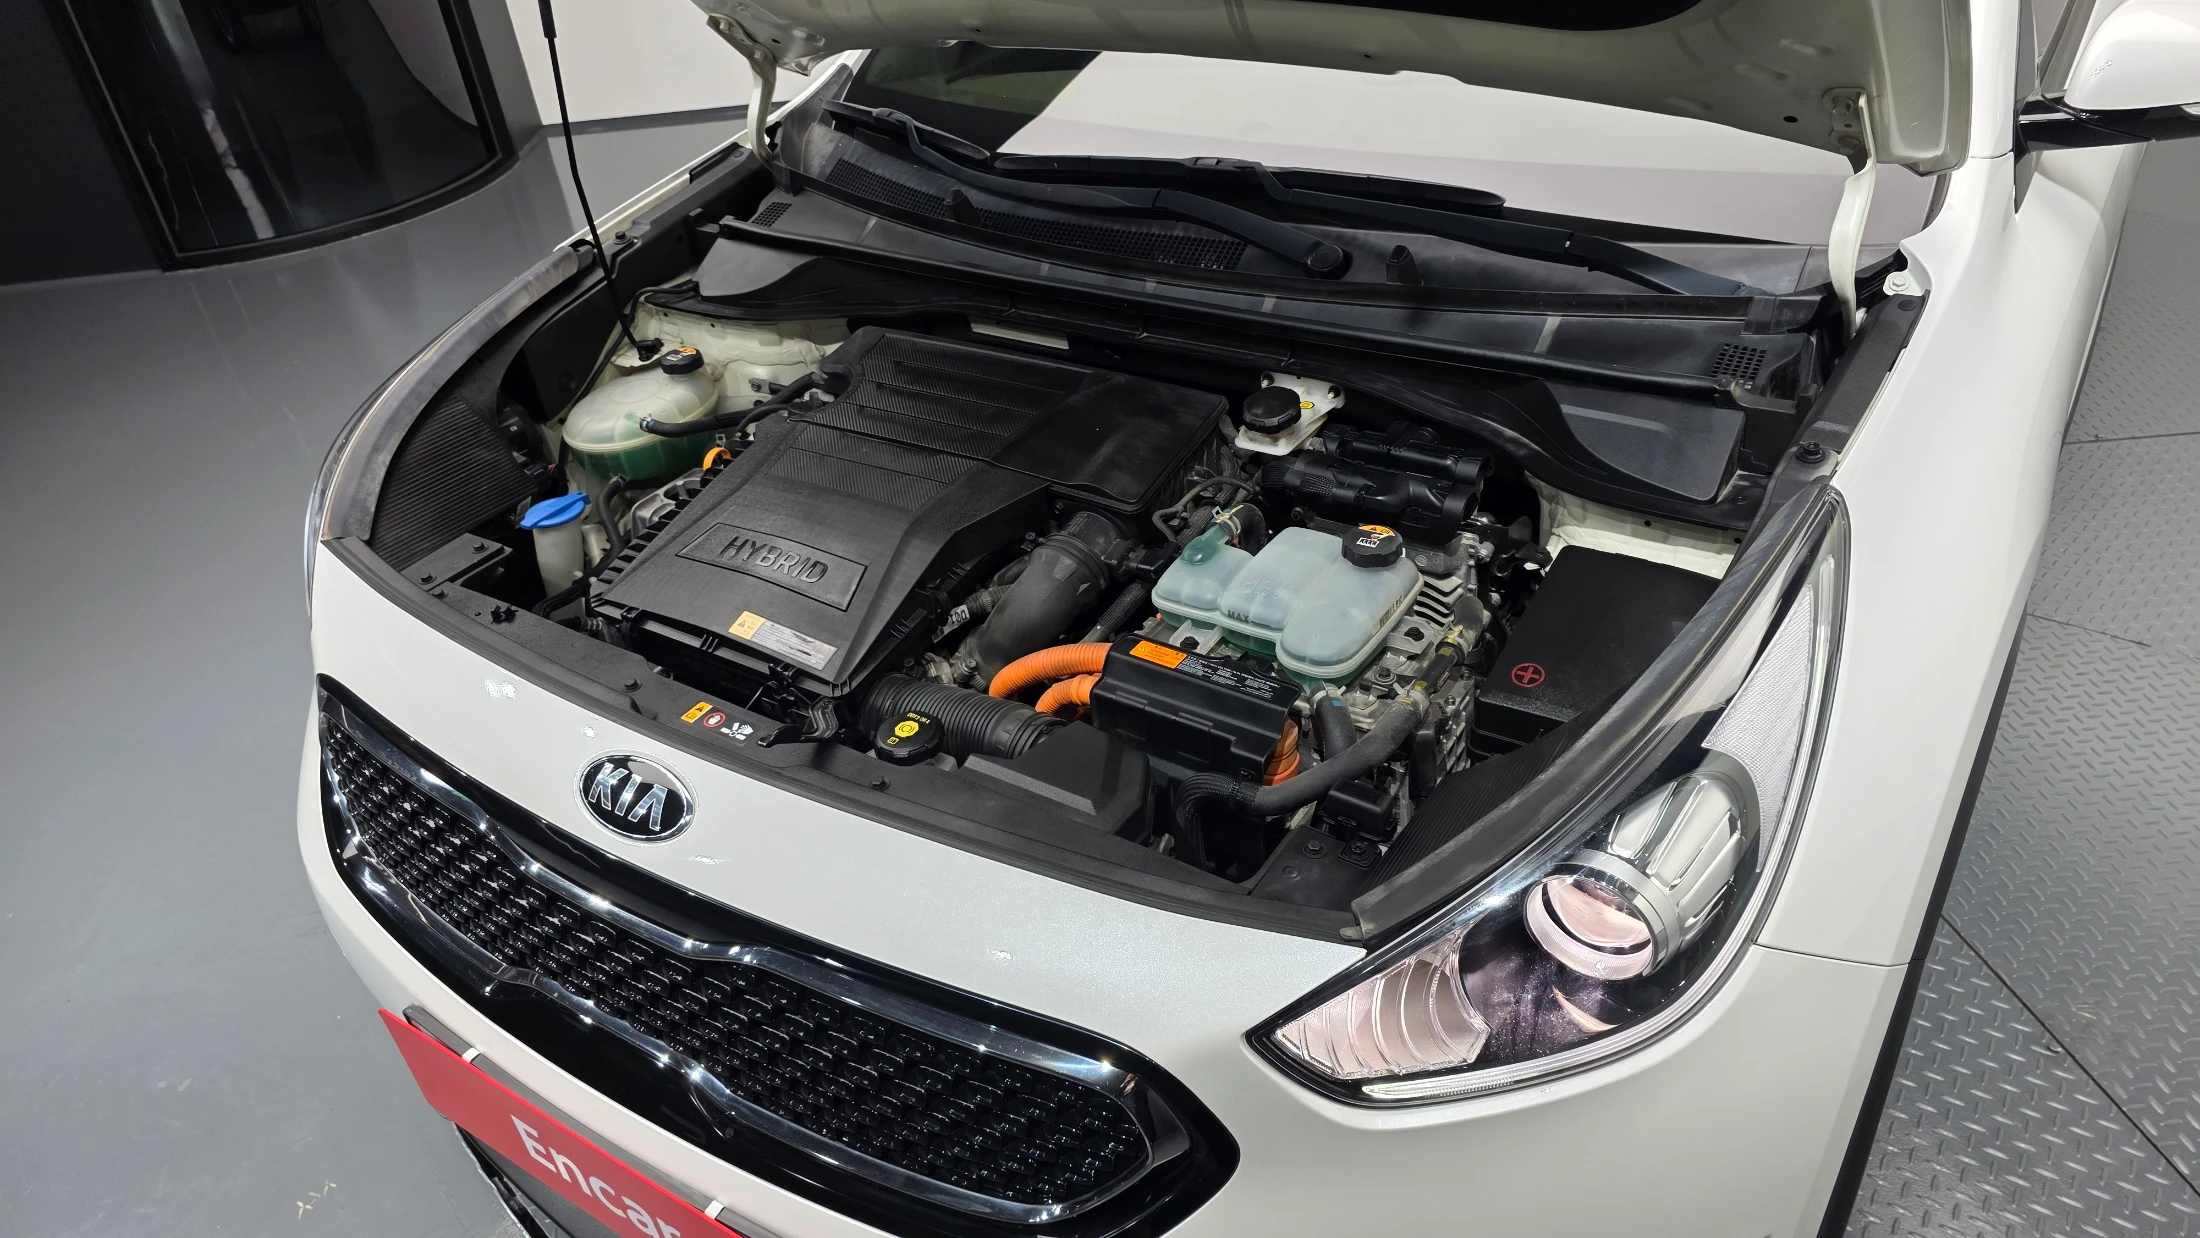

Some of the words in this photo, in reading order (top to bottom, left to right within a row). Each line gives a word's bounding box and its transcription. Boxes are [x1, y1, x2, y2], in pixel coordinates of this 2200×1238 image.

[719, 535, 829, 583] HYBRID
[1227, 609, 1250, 624] MAX
[588, 761, 669, 831] KIA
[510, 1113, 681, 1238] Encar
